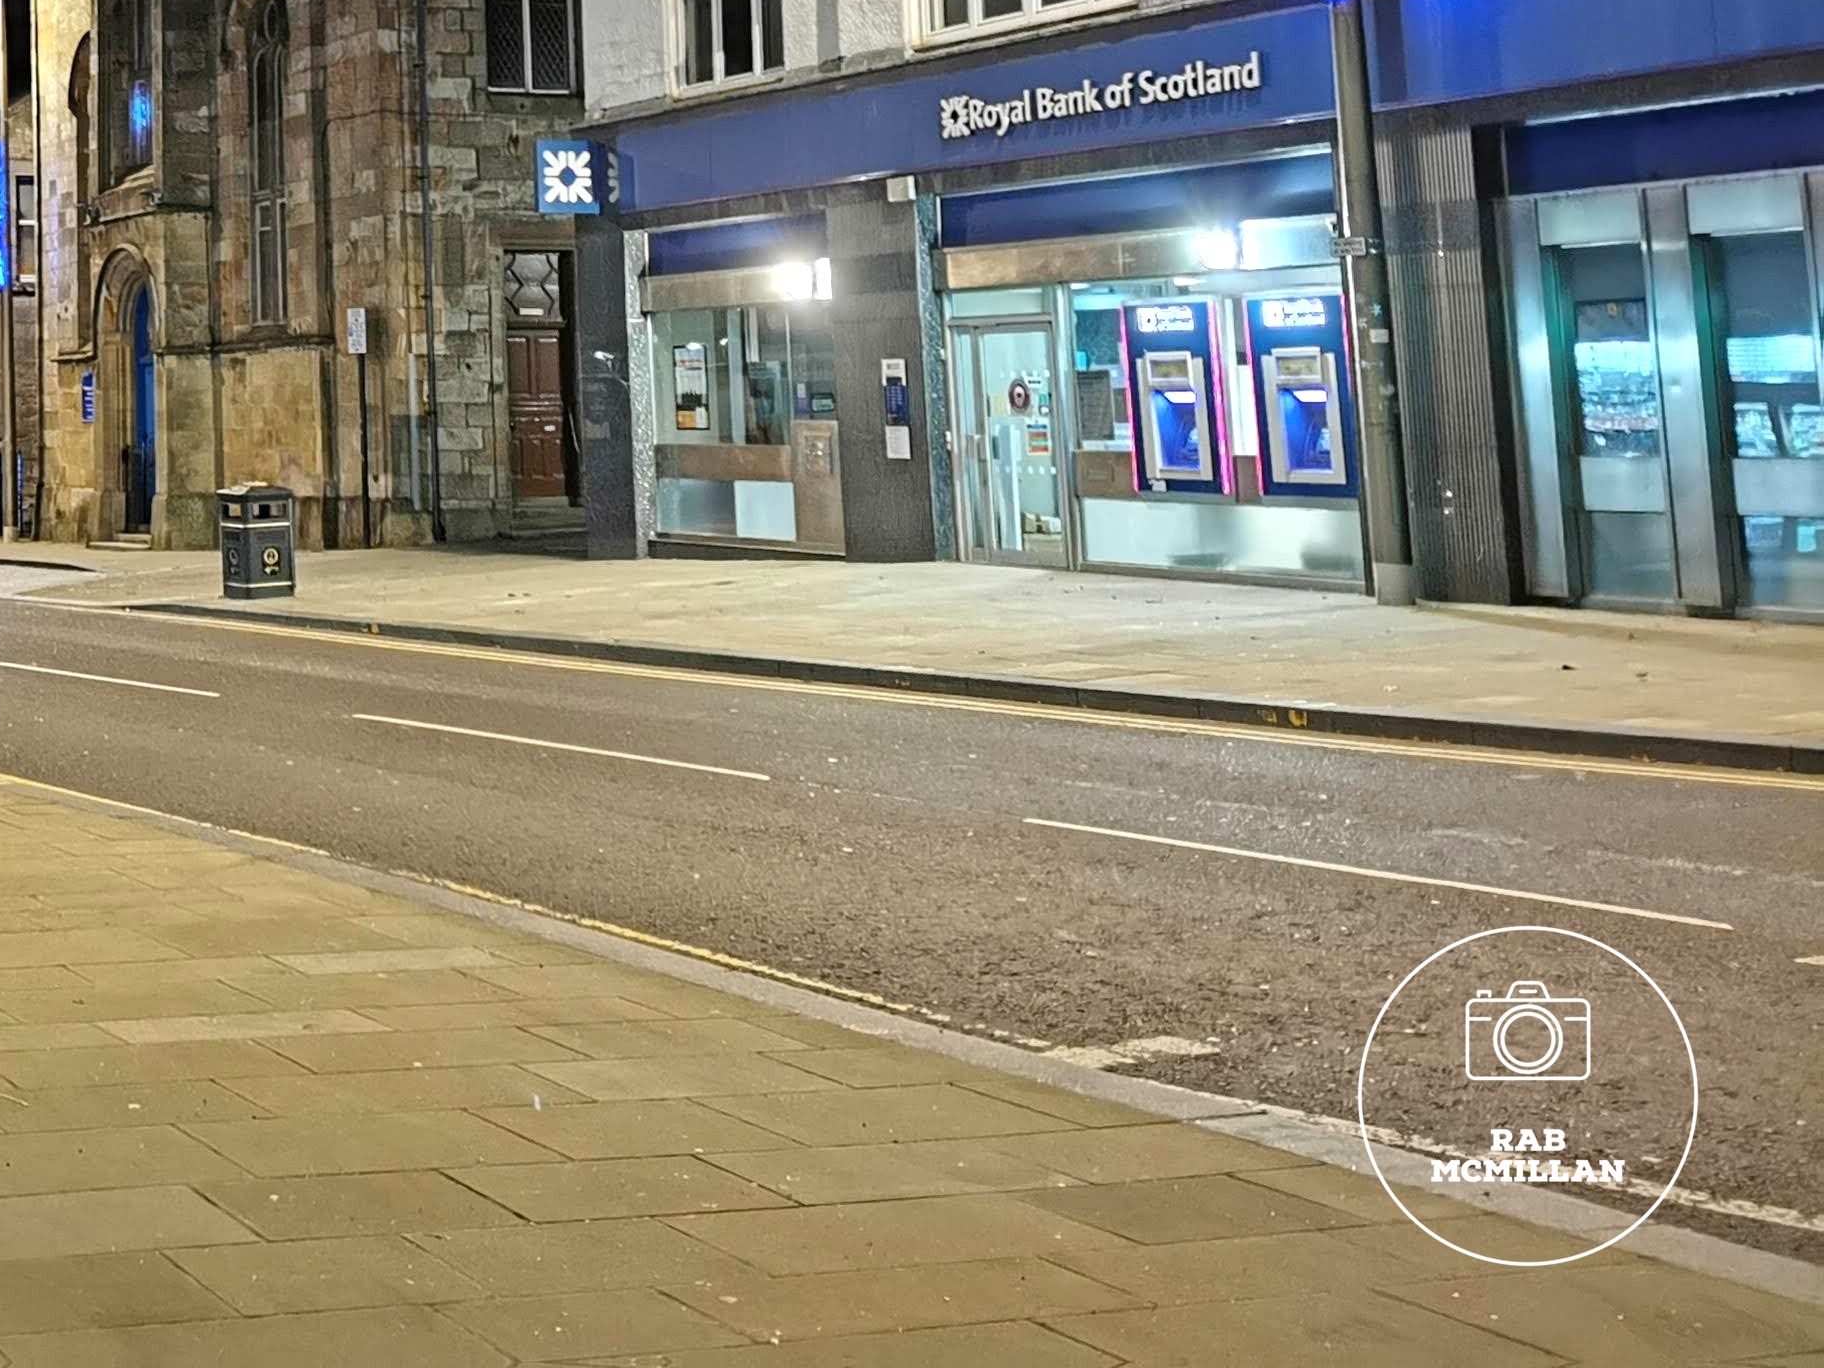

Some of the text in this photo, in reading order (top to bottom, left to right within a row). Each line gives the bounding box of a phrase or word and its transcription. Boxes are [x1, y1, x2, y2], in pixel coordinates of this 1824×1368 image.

[969, 50, 1261, 136] Royal Bank of Scotland
